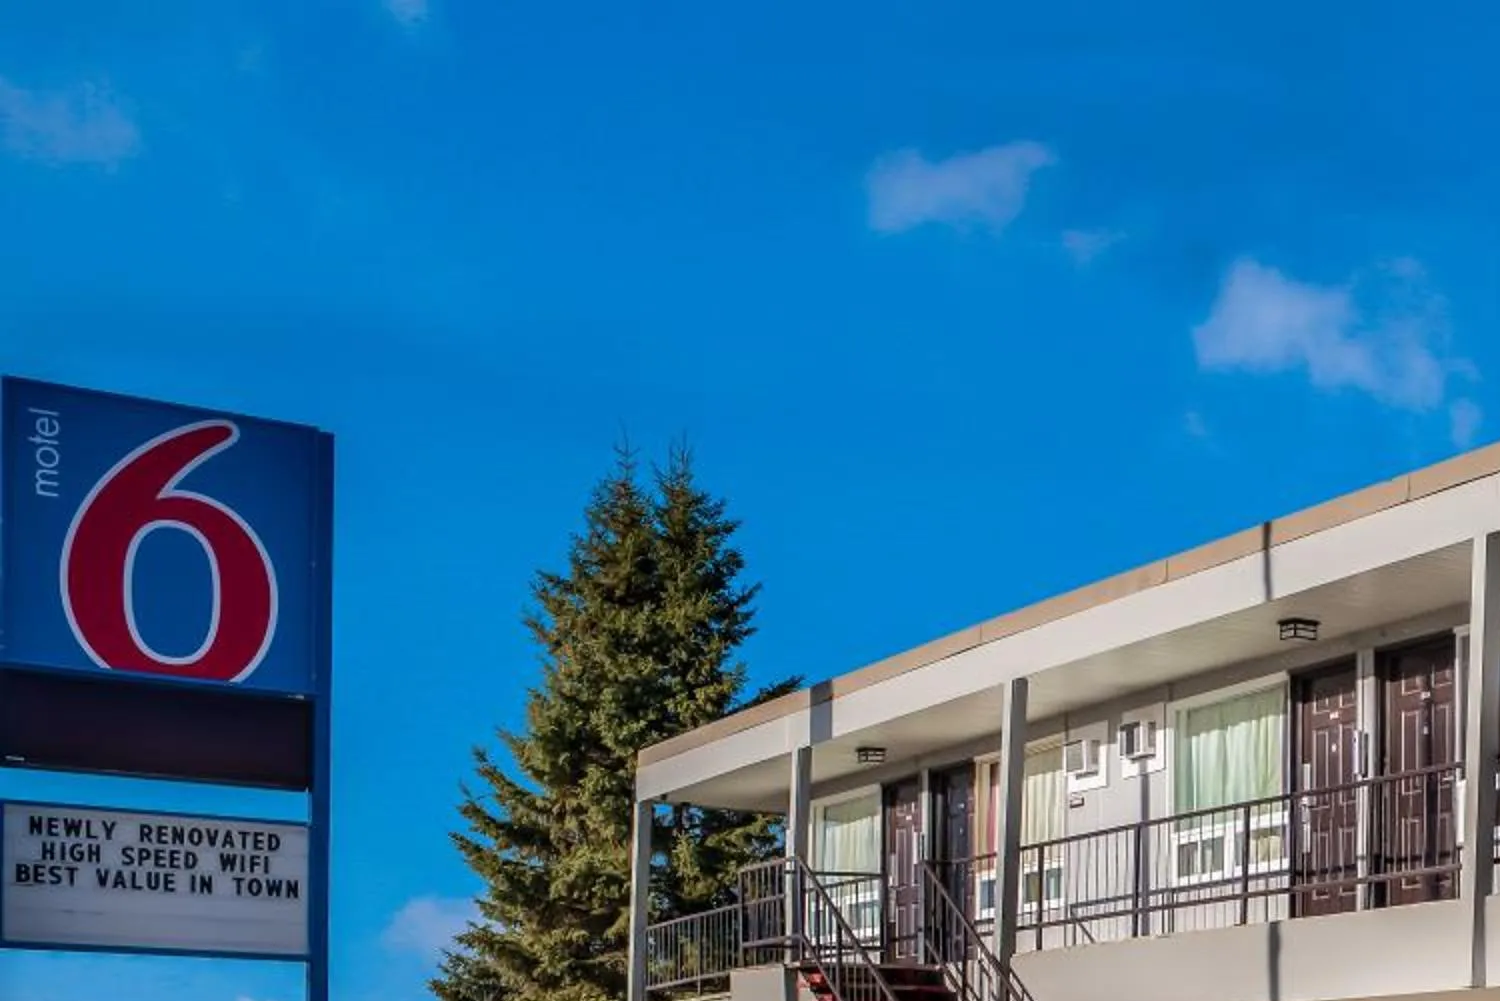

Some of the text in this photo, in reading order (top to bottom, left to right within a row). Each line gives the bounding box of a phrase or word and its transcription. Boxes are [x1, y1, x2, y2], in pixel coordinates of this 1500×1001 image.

[28, 407, 60, 497] motel
[59, 419, 279, 683] 6
[28, 815, 281, 851] NEWLY RENOVATED
[41, 841, 270, 874] HIGH SPEED WIFI
[15, 863, 299, 898] BEST VALUE IN TOWN
